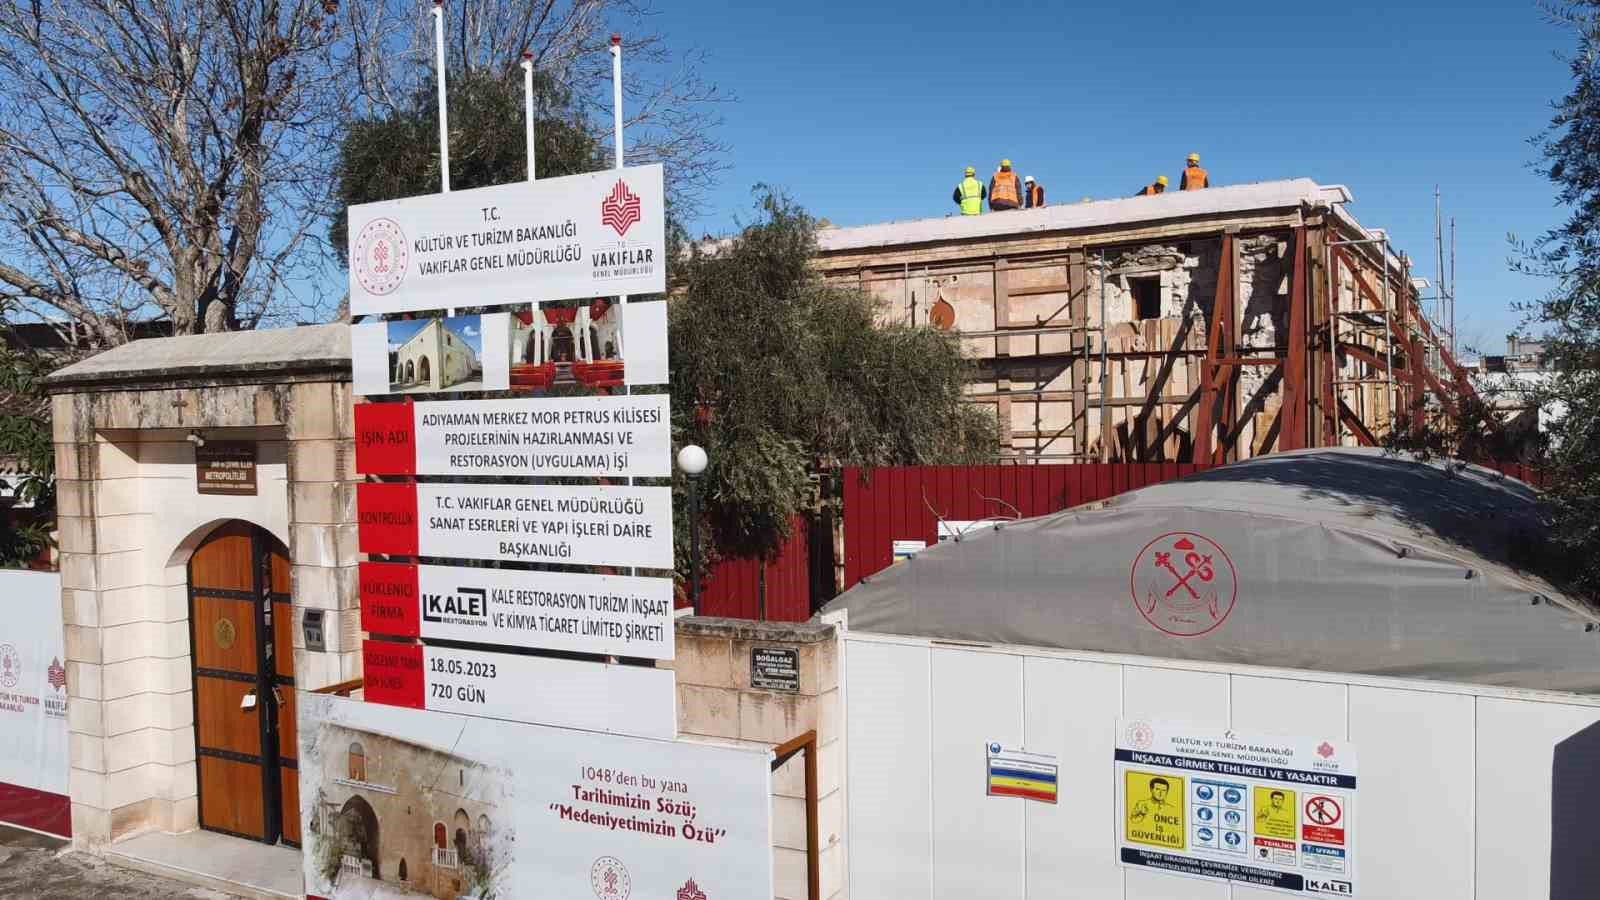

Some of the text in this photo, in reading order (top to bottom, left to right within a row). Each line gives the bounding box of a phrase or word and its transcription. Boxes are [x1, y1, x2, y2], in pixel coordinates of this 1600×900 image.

[482, 207, 501, 221] T.C.
[414, 219, 577, 253] KÜLTÜR VE TURİZM BAKANLIĞI
[419, 243, 582, 276] VAKIFLAR GENEL MÜDÜRLÜĞÜ
[592, 248, 653, 267] VAKIFLAR
[422, 406, 661, 427] ADIYAMAN MERKEZ MOR PETRUS KİLİSESİ
[446, 430, 633, 446] PROJELERİNİN HAZIRLANMASI VE
[450, 452, 628, 471] RESTORASYON (UYGULAMA) İŞİ
[435, 496, 643, 515] T.C. VAKIFLAR GENEL MÜDÜRLÜĞÜ
[430, 516, 652, 539] SANAT ESERLERİ VE YAPI İŞLERİ DAİRE
[500, 540, 571, 558] BAŞKANLIĞI
[430, 595, 481, 617] KALE
[492, 588, 669, 619] KALE RESTORASYON TURİZM İNŞAAT
[493, 611, 664, 643] VE KİMYA TİCARET LİMİTED ŞİRKETİ
[431, 657, 497, 679] 18.05.2023
[432, 684, 486, 703] 720 GÜN
[1132, 751, 1337, 785] İNŞAATA GİRMEK TEHLİKELİ VE YASAKTIR
[582, 766, 688, 794] 1048'den bu yana
[572, 784, 696, 820] Tarihimizin Sözü;
[1310, 881, 1348, 893] KALE
